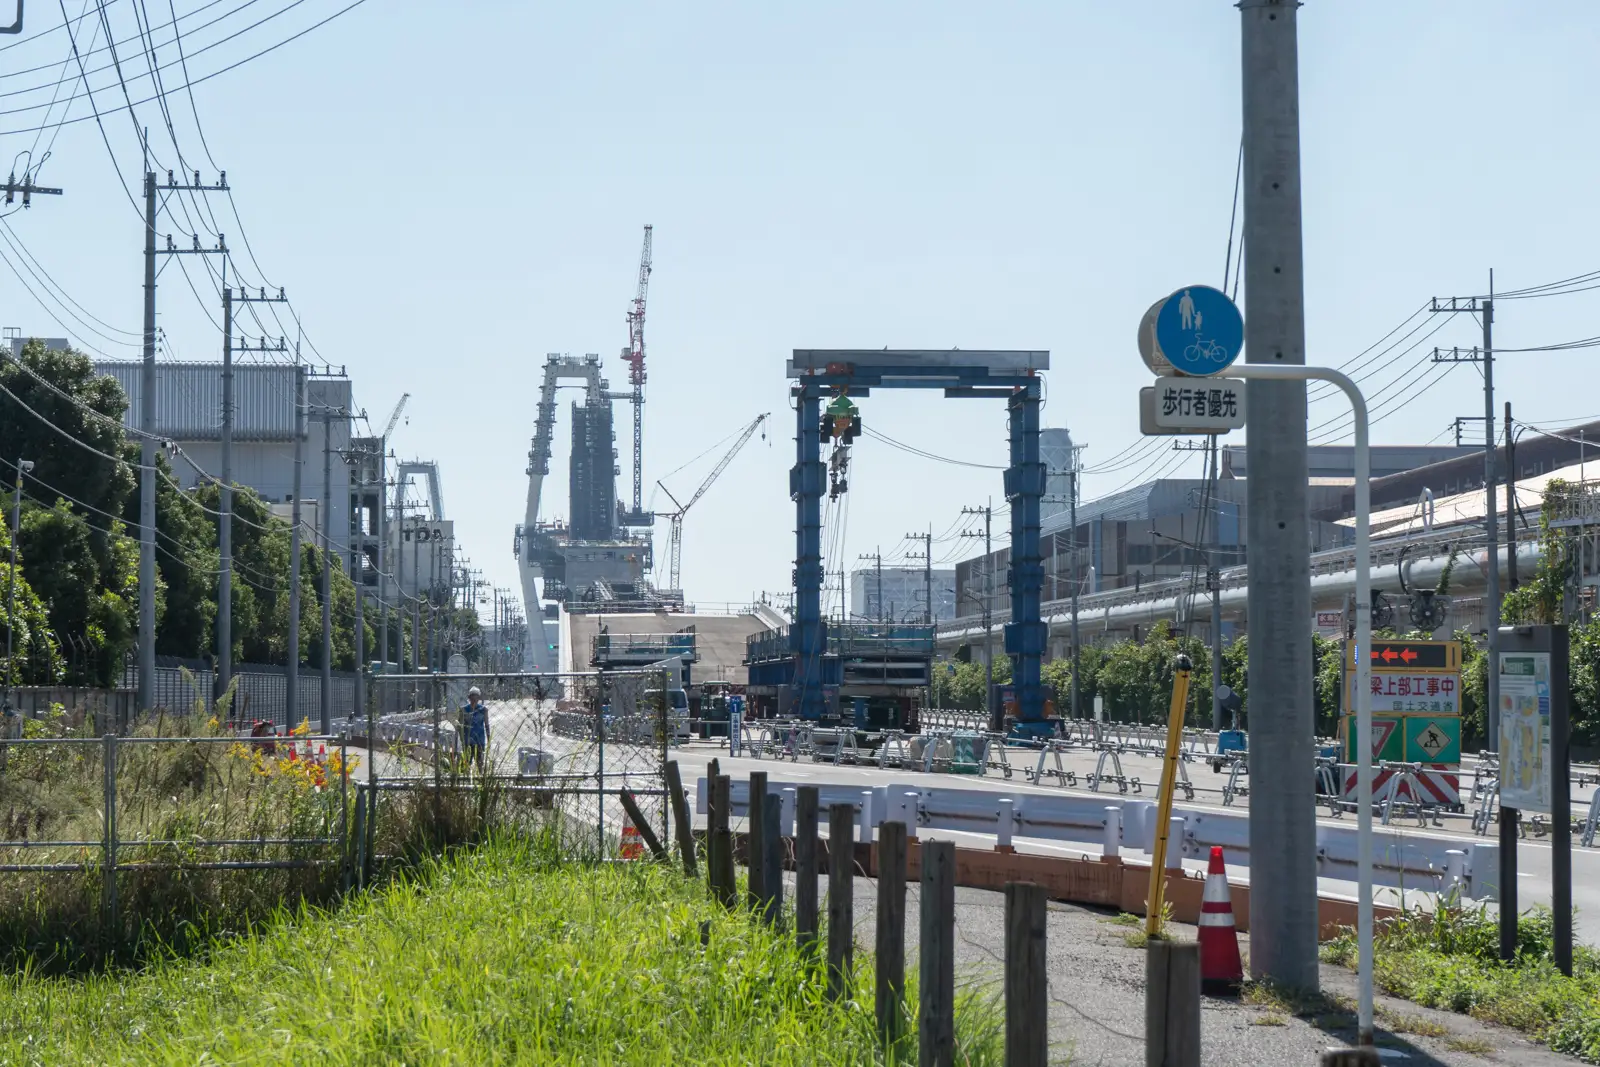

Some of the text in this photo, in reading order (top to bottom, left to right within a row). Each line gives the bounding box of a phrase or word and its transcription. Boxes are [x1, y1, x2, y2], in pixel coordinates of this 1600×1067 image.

[1163, 387, 1237, 417] 歩行者優先
[1354, 676, 1454, 696] 梁上部工事中
[1393, 700, 1453, 711] 国土交通省
